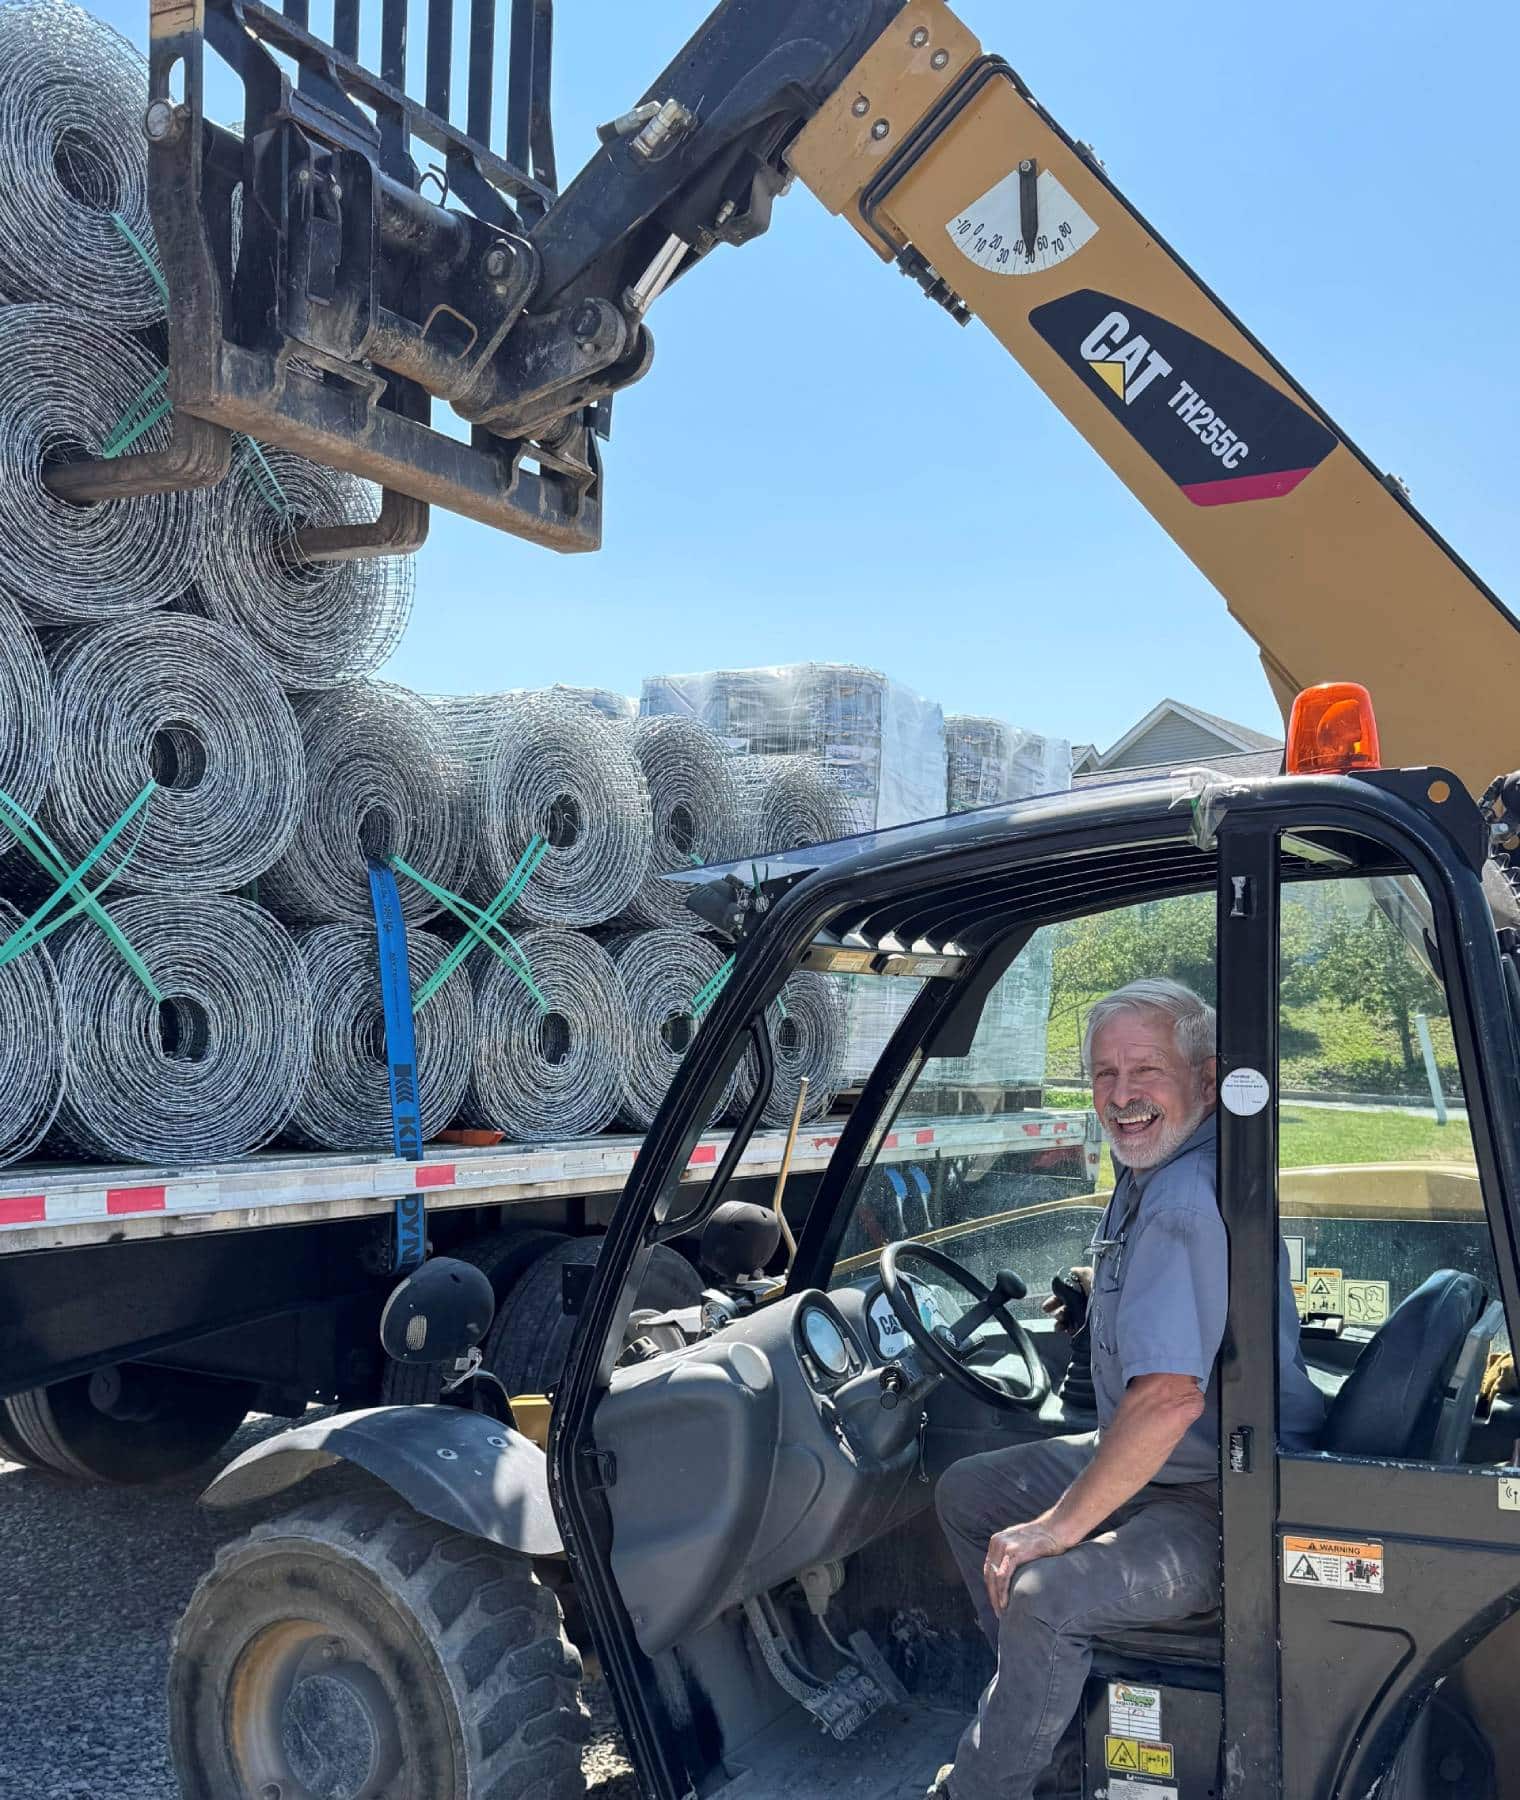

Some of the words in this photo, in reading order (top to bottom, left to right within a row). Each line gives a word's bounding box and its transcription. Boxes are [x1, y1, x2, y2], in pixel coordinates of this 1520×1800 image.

[973, 223, 985, 235] 0
[1058, 222, 1072, 237] 80
[974, 238, 987, 253] 10
[989, 233, 1003, 249] 20
[1012, 239, 1024, 255] 40
[1037, 235, 1049, 251] 60
[1051, 238, 1065, 255] 70
[996, 248, 1009, 264] 30
[1080, 311, 1173, 406] CAT
[1168, 380, 1249, 469] TH255C
[878, 1314, 904, 1336] CA
[1320, 1543, 1360, 1555] WARNING
